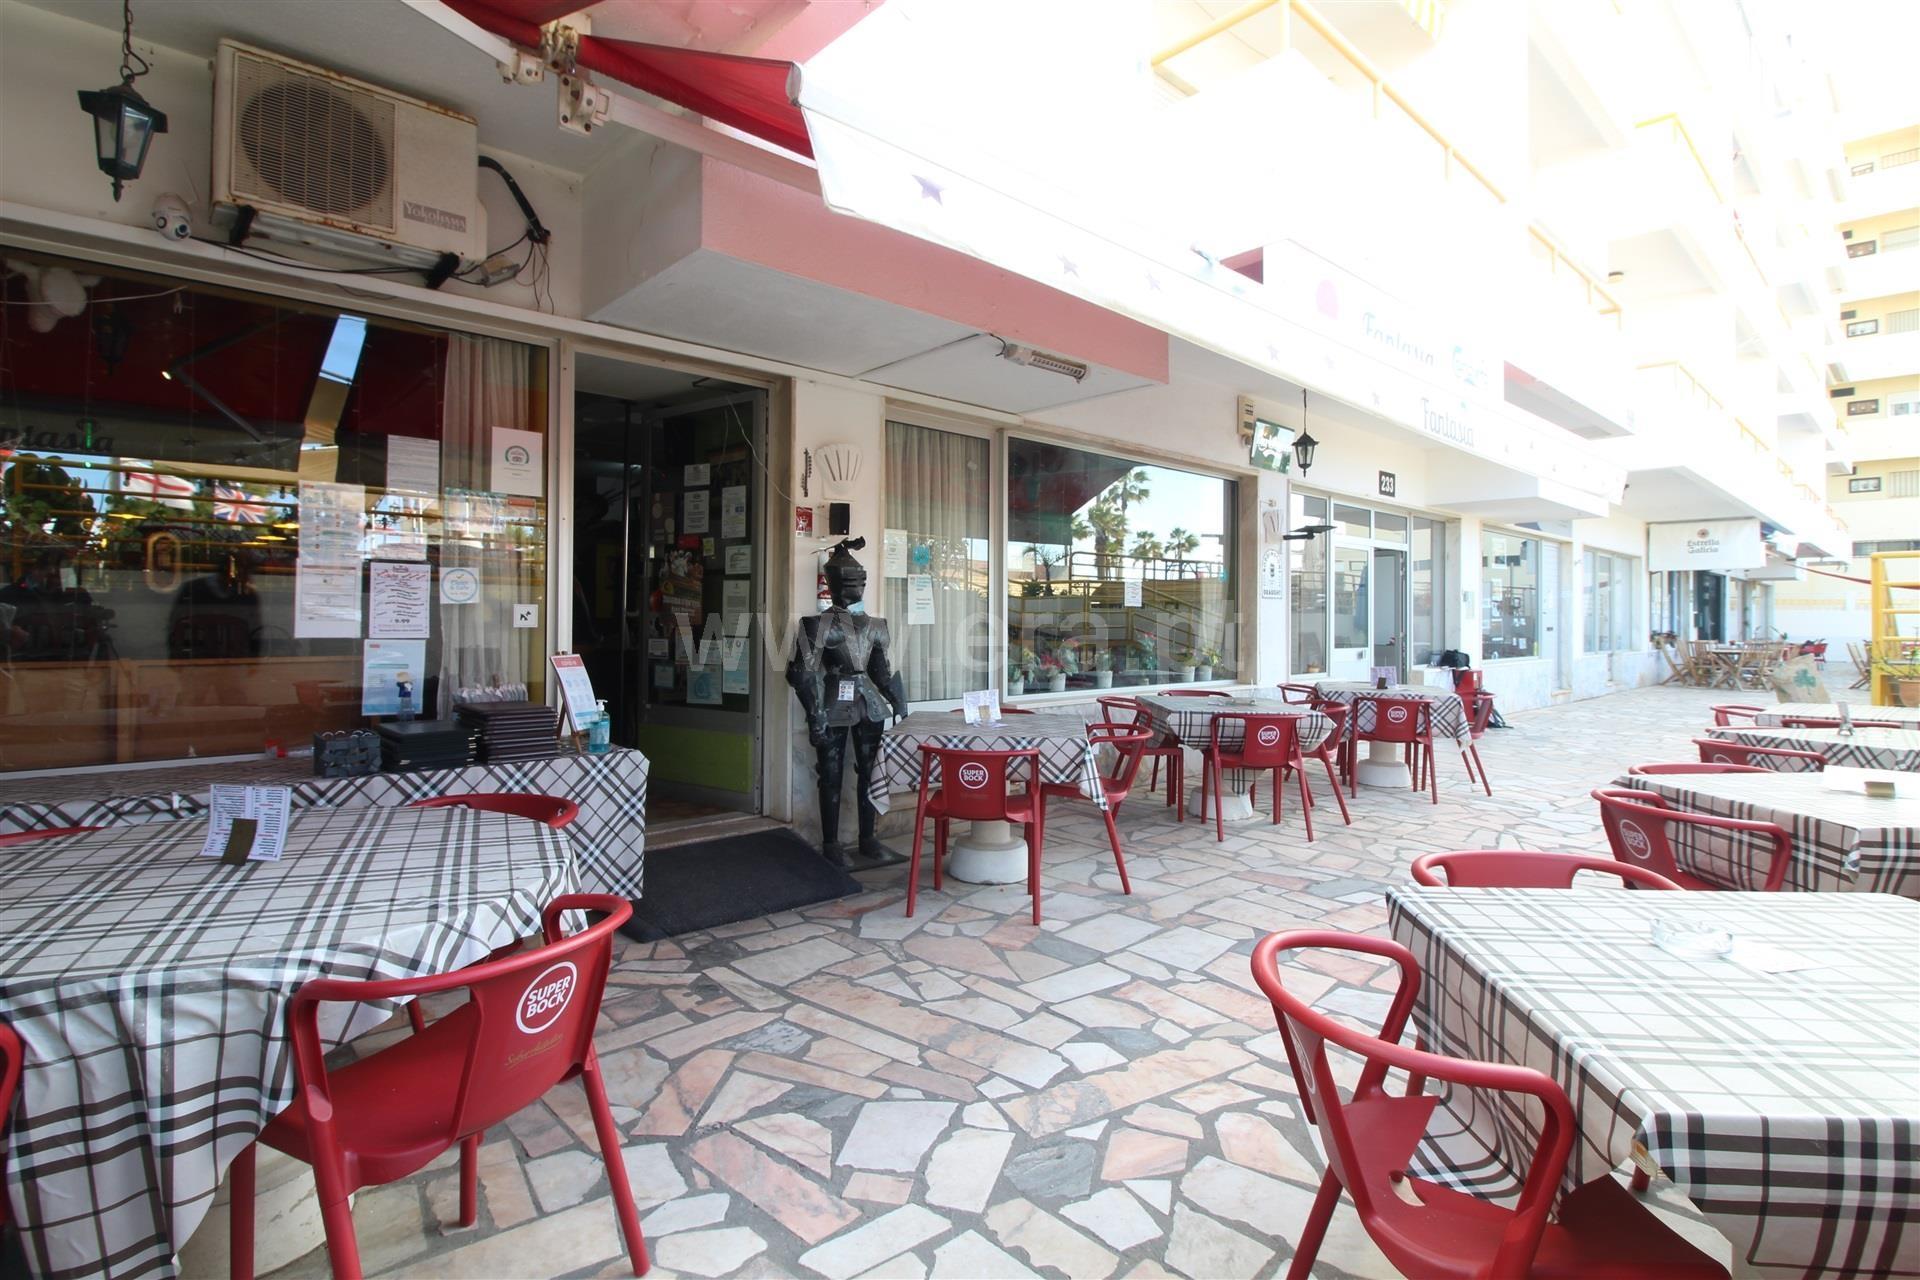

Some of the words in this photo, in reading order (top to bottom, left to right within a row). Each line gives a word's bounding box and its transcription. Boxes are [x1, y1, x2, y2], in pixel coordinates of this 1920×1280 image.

[1420, 397, 1476, 448] Fantasia
[1381, 475, 1394, 493] 233
[1687, 539, 1720, 547] Estrella
[1687, 546, 1719, 554] Galicia
[527, 975, 571, 1005] SUPER
[526, 989, 567, 1019] BOCK
